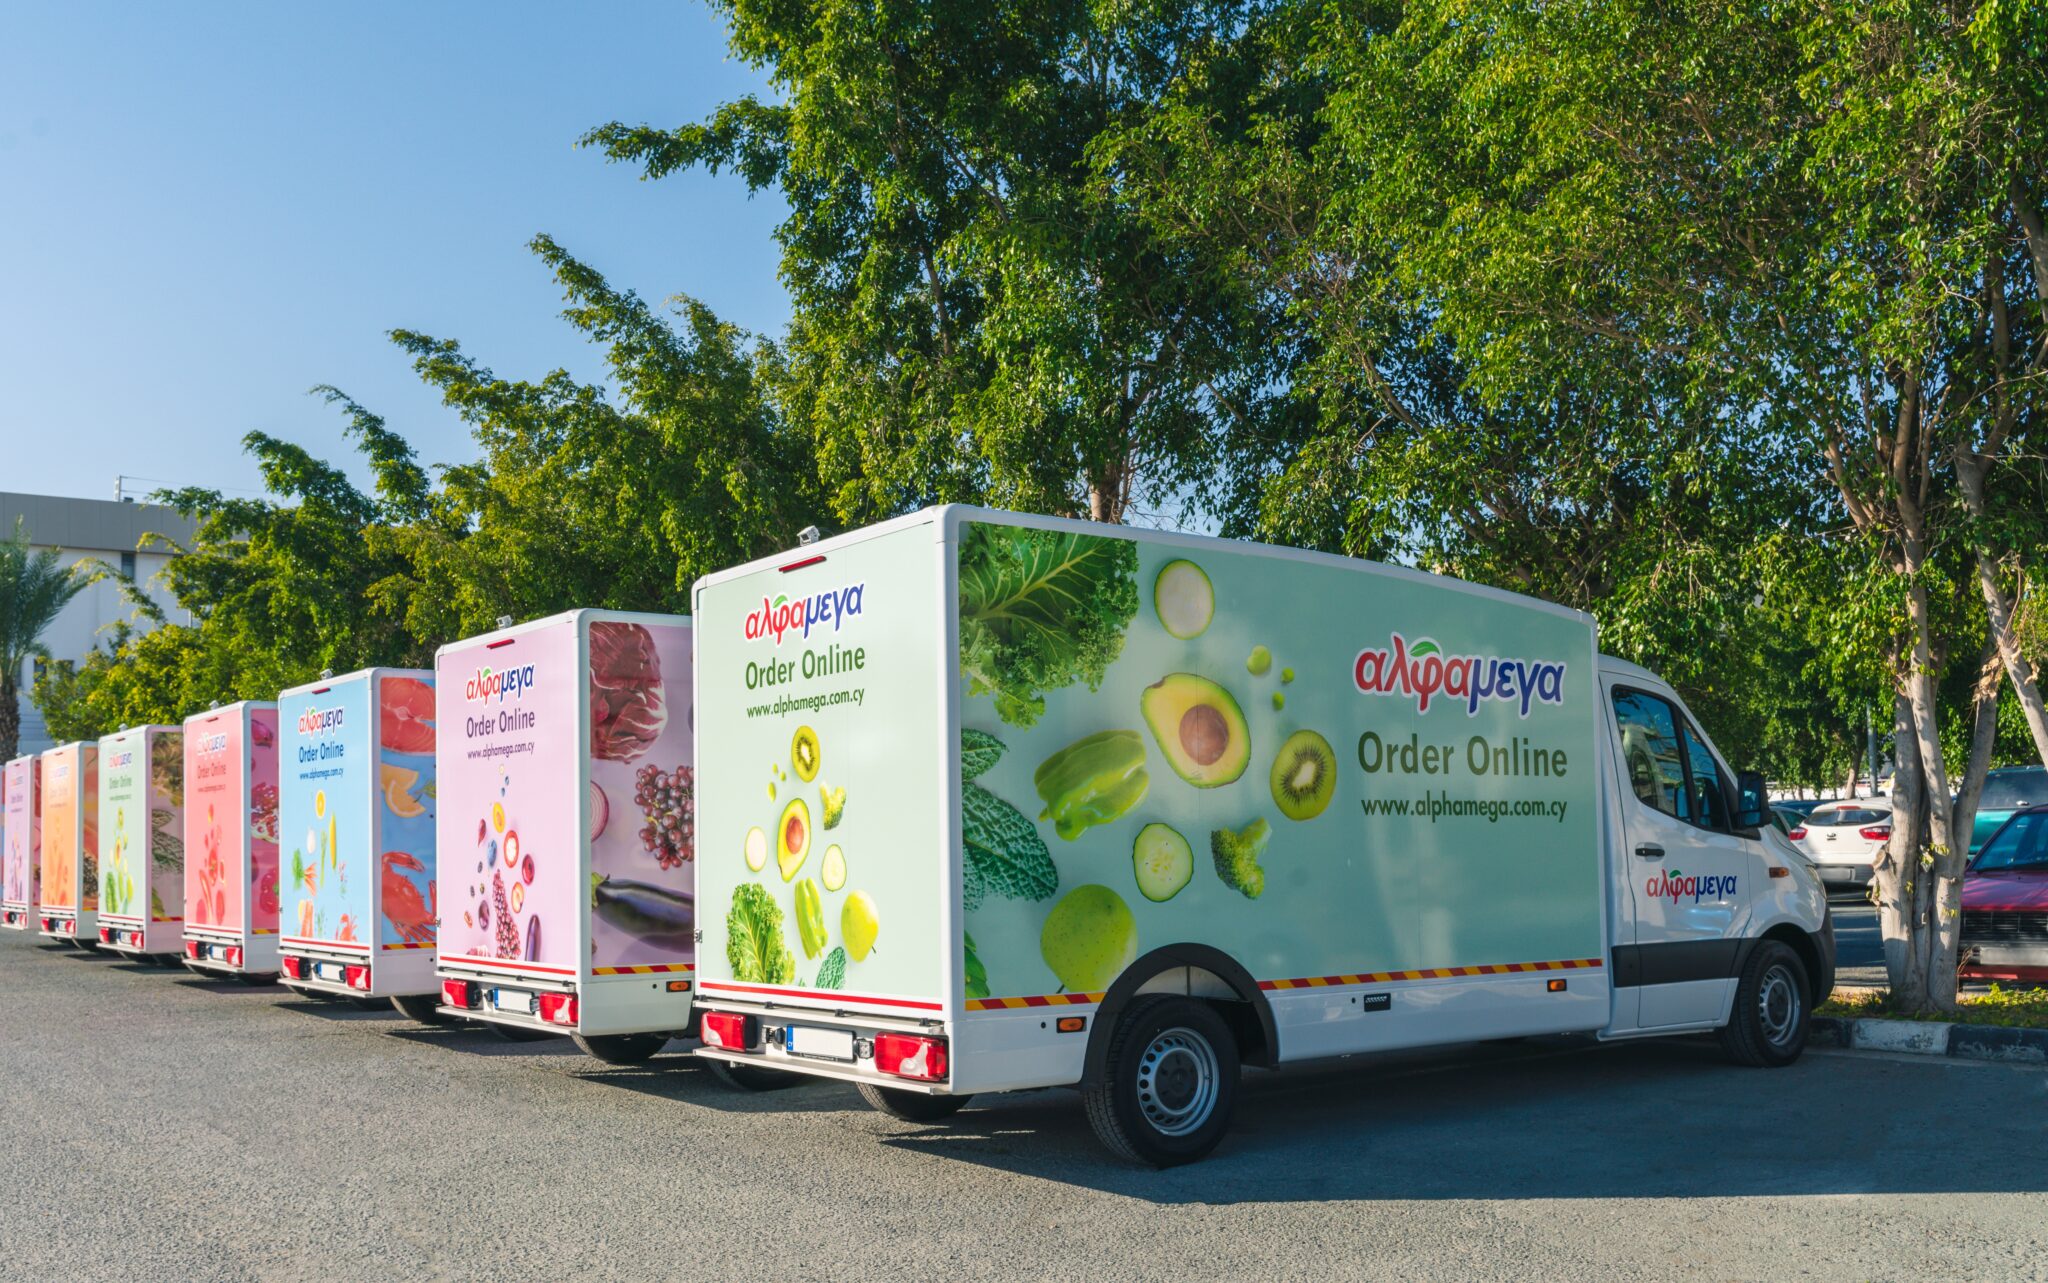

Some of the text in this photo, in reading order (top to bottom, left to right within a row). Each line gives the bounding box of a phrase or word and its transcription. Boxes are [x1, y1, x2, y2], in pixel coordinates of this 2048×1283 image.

[745, 583, 864, 645] αλφαμεγα
[466, 664, 535, 706] αλφαμεγα
[745, 643, 866, 690] Order Online
[1355, 634, 1565, 716] αλφαμεγα
[746, 688, 865, 718] www.alphamega.com.cy
[466, 707, 535, 738] Order Online
[298, 741, 345, 763] Order Online
[467, 741, 535, 760] www.alphamega.com.cy
[1357, 731, 1568, 777] Order Online
[1360, 790, 1568, 823] www.alphamega.com.cy
[1645, 868, 1738, 905] αλφαμεγα
